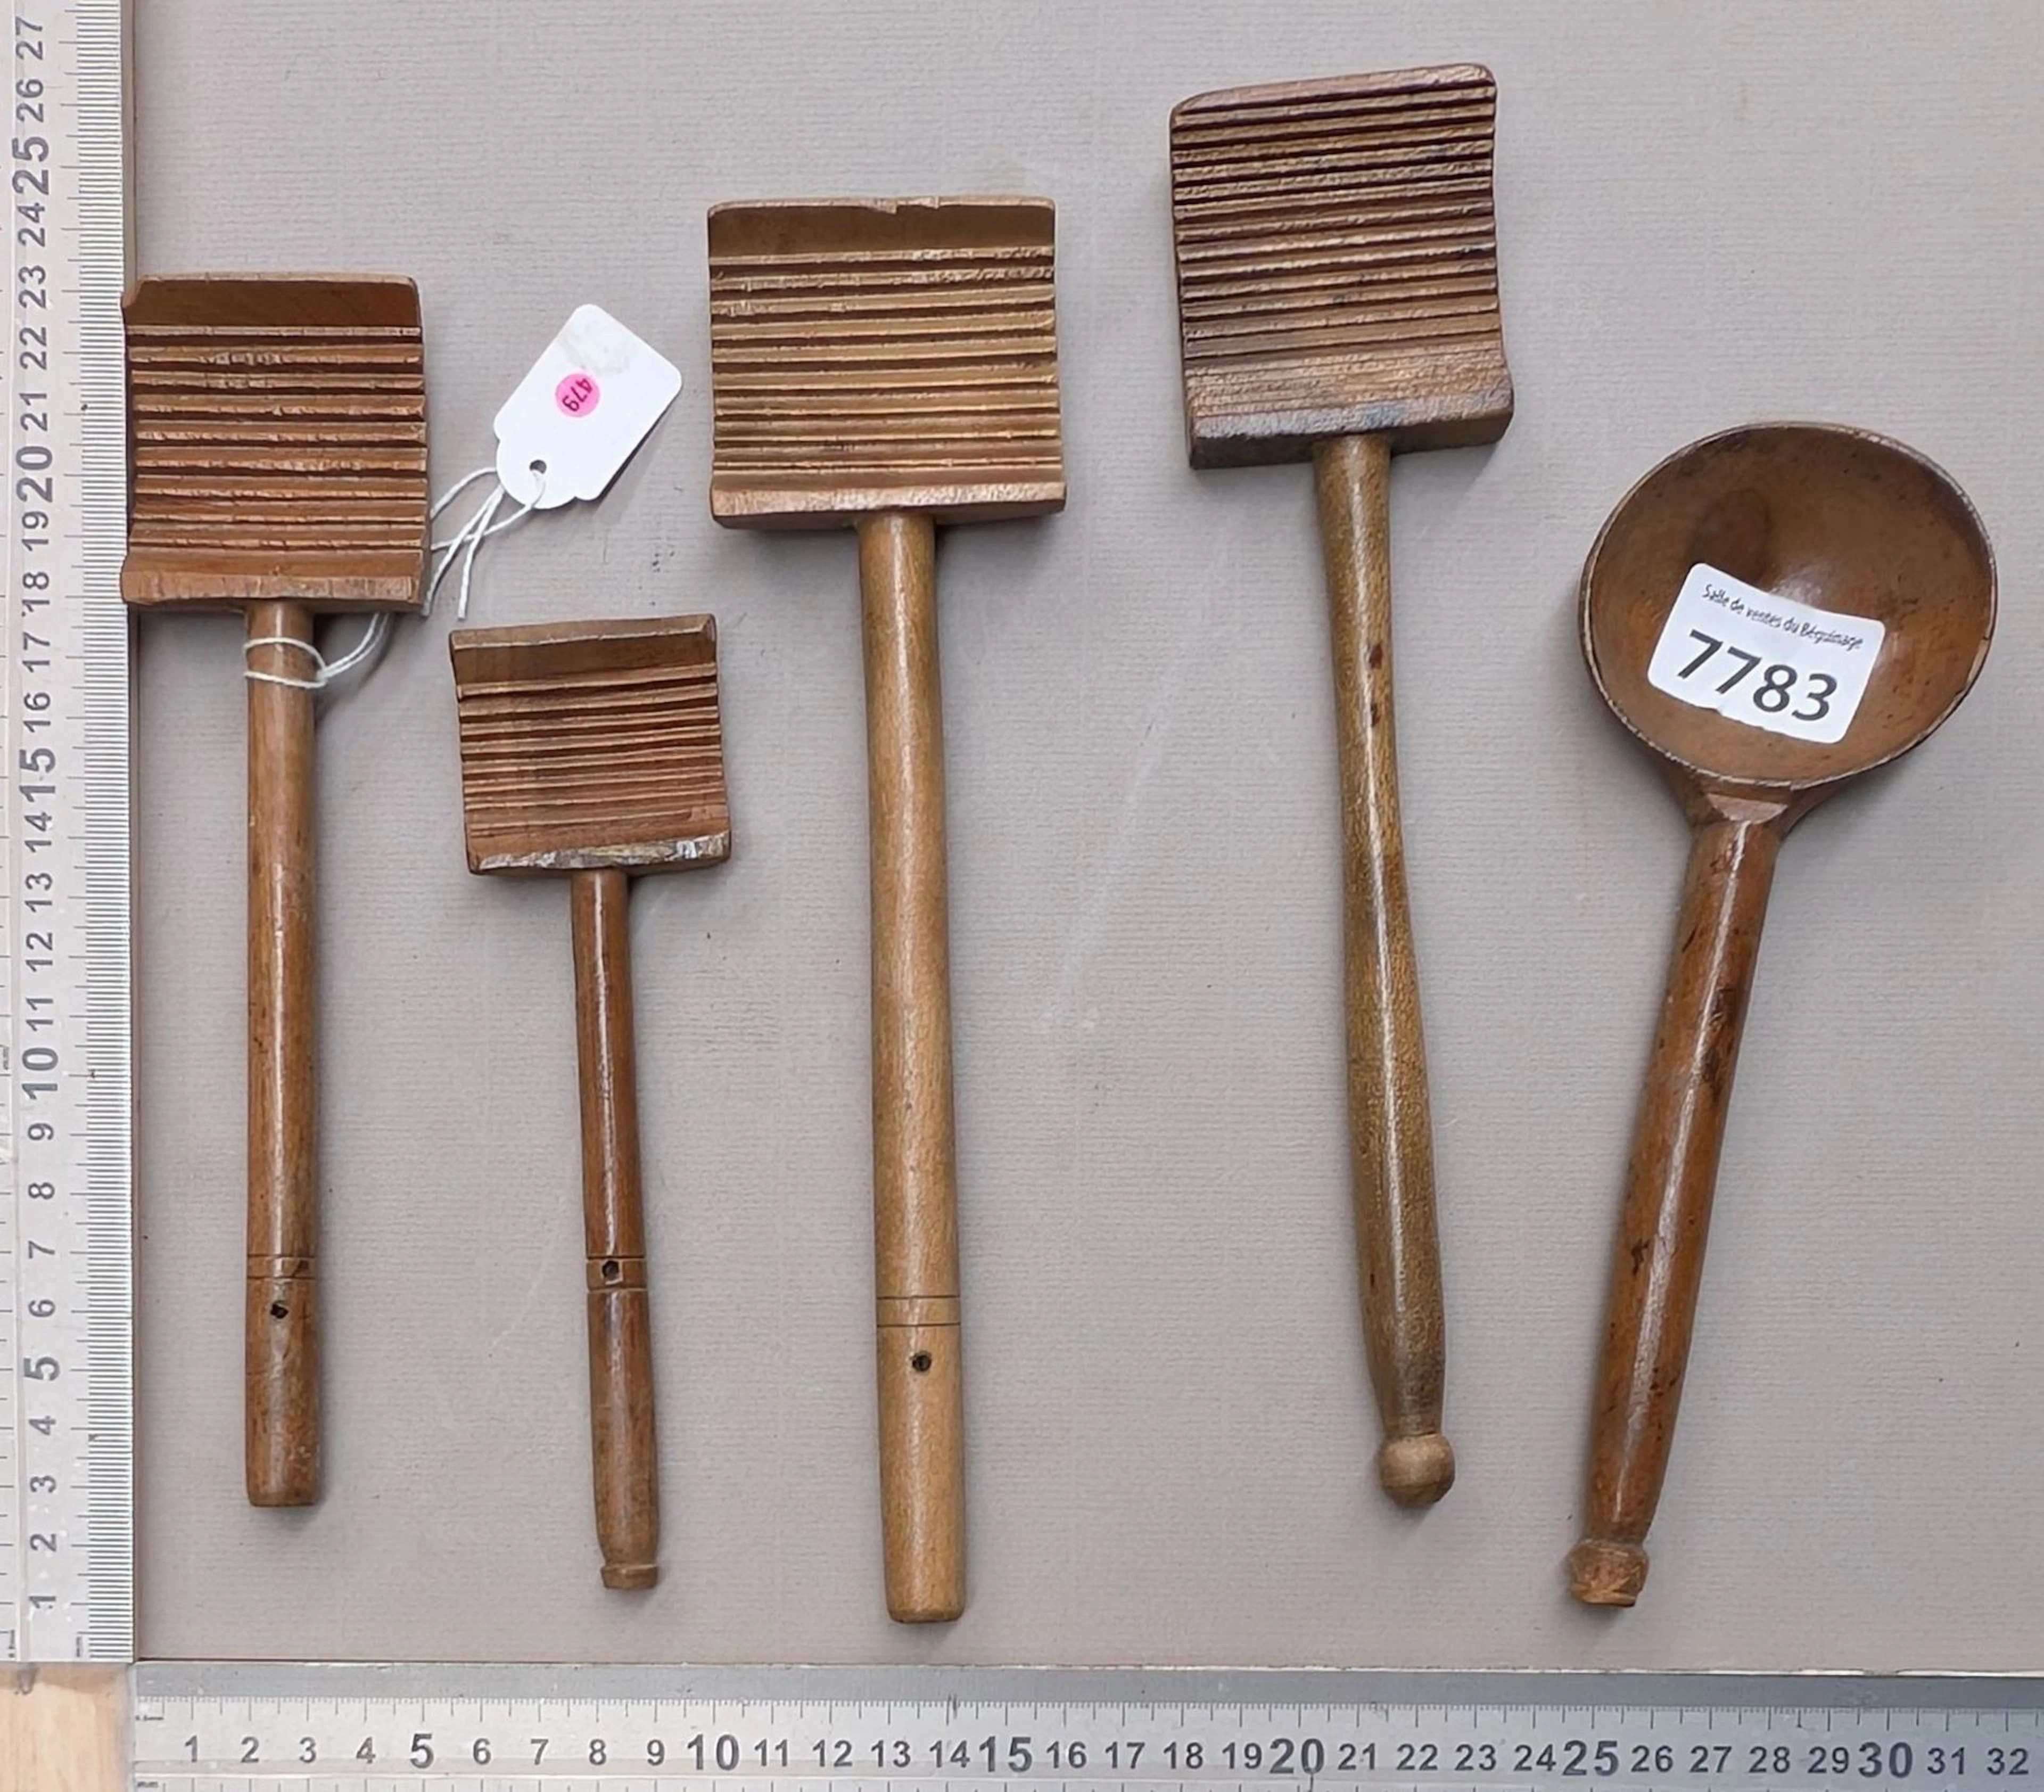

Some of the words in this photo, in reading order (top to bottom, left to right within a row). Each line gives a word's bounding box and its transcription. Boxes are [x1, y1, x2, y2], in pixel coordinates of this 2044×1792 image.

[15, 16, 43, 60] 27
[15, 79, 44, 123] 26
[12, 137, 49, 195] 25
[15, 196, 45, 247] 24
[18, 265, 46, 309] 23
[19, 327, 47, 371] 22
[19, 393, 48, 432] 21
[563, 377, 592, 412] 479
[14, 446, 53, 503] 20
[21, 511, 49, 552] 19
[21, 572, 50, 612] 18
[1702, 583, 1729, 607] Salle
[1730, 597, 1745, 614] de
[22, 632, 50, 673] 17
[1677, 629, 1837, 721] 7783
[22, 692, 51, 733] 16
[19, 748, 56, 802] 15
[24, 811, 52, 853] 14
[24, 873, 53, 913] 13
[25, 933, 53, 972] 12
[26, 998, 53, 1032] 11
[21, 1048, 59, 1100] 10
[27, 1123, 54, 1140] 9
[28, 1182, 55, 1200] 8
[28, 1240, 55, 1259] 7
[28, 1300, 55, 1317] 6
[23, 1357, 60, 1381] 5
[29, 1416, 56, 1435] 4
[29, 1475, 56, 1493] 3
[29, 1534, 57, 1552] 2
[29, 1596, 56, 1609] 1
[185, 1736, 197, 1763] 1
[240, 1737, 259, 1764] 2
[299, 1737, 316, 1764] 3
[356, 1737, 376, 1764] 4
[409, 1733, 434, 1769] 5
[473, 1738, 491, 1765] 6
[531, 1739, 549, 1766] 7
[589, 1739, 606, 1766] 8
[647, 1739, 665, 1766] 9
[687, 1733, 739, 1771] 10
[754, 1739, 788, 1768] 11
[813, 1739, 853, 1768] 12
[871, 1740, 911, 1768] 13
[929, 1740, 970, 1768] 14
[979, 1736, 1032, 1773] 15
[1046, 1741, 1086, 1769] 16
[1105, 1741, 1145, 1769] 17
[1164, 1741, 1203, 1770] 18
[1222, 1742, 1262, 1770] 19
[1269, 1738, 1324, 1774] 20
[1338, 1743, 1375, 1771] 21
[1396, 1744, 1438, 1771] 22
[1454, 1744, 1496, 1771] 23
[1513, 1745, 1556, 1772] 24
[1562, 1740, 1619, 1777] 25
[1631, 1745, 1674, 1773] 26
[1689, 1746, 1732, 1773] 27
[1748, 1746, 1790, 1773] 28
[1808, 1746, 1849, 1774] 29
[1858, 1742, 1913, 1778] 30
[1927, 1747, 1964, 1774] 31
[1987, 1748, 2029, 1775] 32
